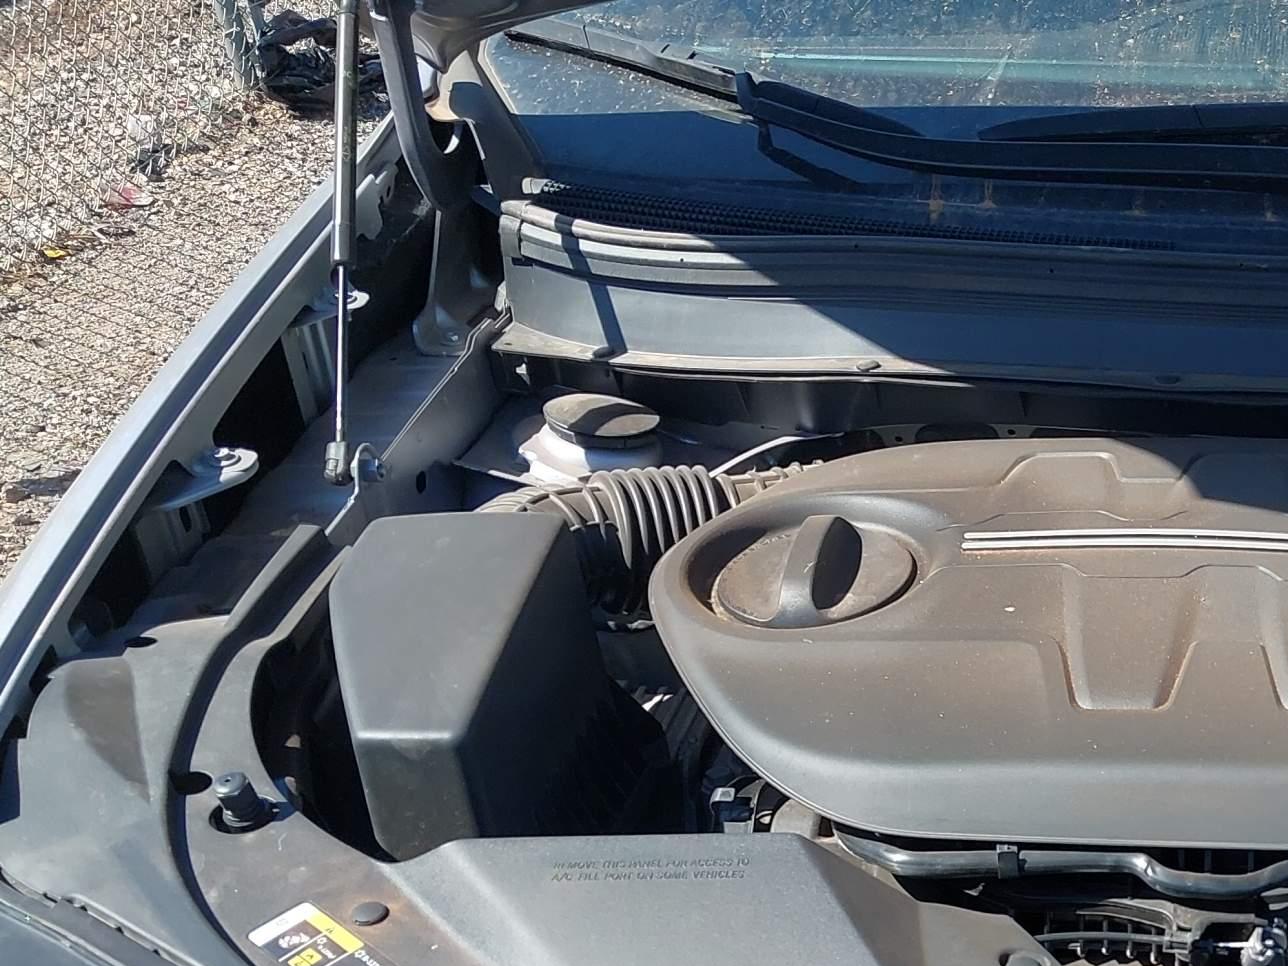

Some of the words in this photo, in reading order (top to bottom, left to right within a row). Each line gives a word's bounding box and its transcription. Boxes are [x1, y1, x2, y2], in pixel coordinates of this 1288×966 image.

[602, 859, 626, 869] THIS
[689, 857, 733, 868] ACCESS
[736, 855, 751, 867] TO
[692, 868, 746, 880] VEHICLES
